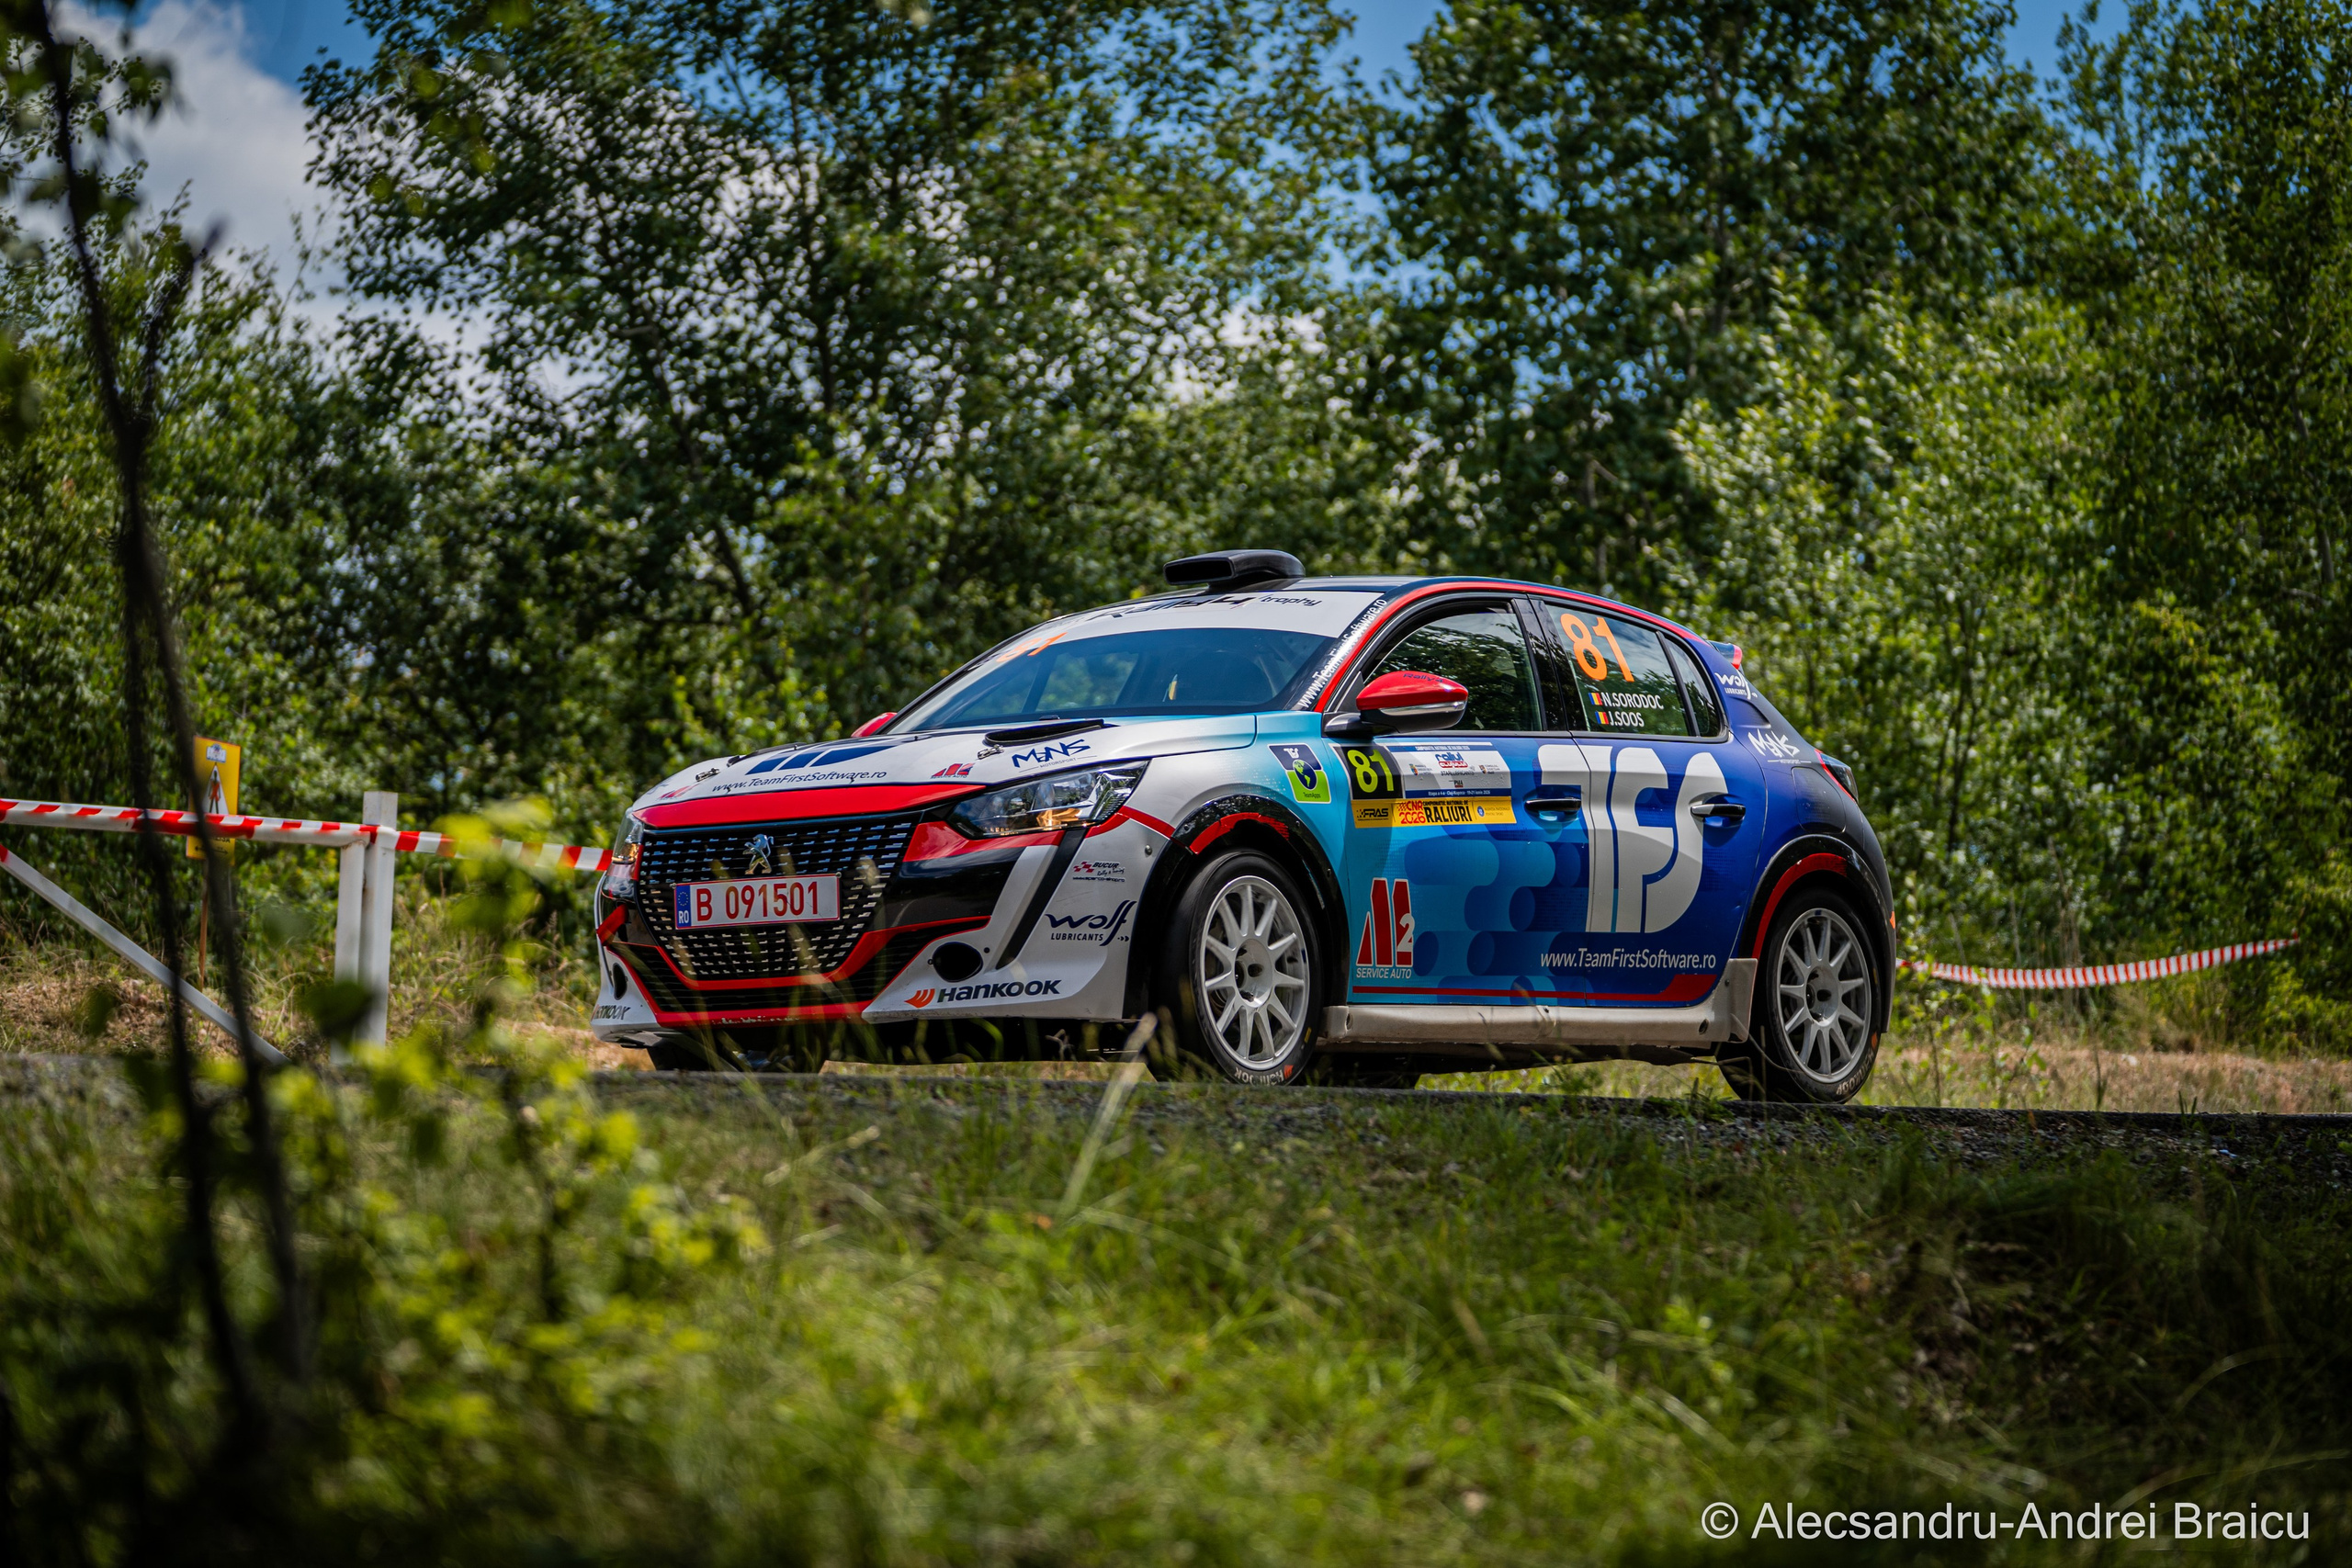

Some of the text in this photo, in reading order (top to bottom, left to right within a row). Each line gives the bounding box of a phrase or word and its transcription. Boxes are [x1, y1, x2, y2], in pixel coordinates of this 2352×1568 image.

[996, 631, 1069, 662] 81
[1559, 613, 1635, 682] 81
[1600, 692, 1664, 709] N.SORODOC
[1608, 710, 1645, 727] J.SOOS
[1039, 757, 1077, 768] MOTORSPORT
[1347, 749, 1395, 794] 81
[711, 770, 888, 793] www.TeamFirstSoftware.ro
[1363, 808, 1389, 818] FRAS
[1406, 800, 1423, 811] CNR
[1398, 811, 1426, 824] 2026
[1423, 806, 1473, 823] RALIURI
[696, 881, 819, 921] B 091501
[678, 910, 689, 923] RO
[1050, 932, 1103, 942] LUBRICANTS
[1540, 948, 1716, 969] www.TeamFirstSoftware.ro
[1356, 967, 1412, 979] SERVICE AUTO
